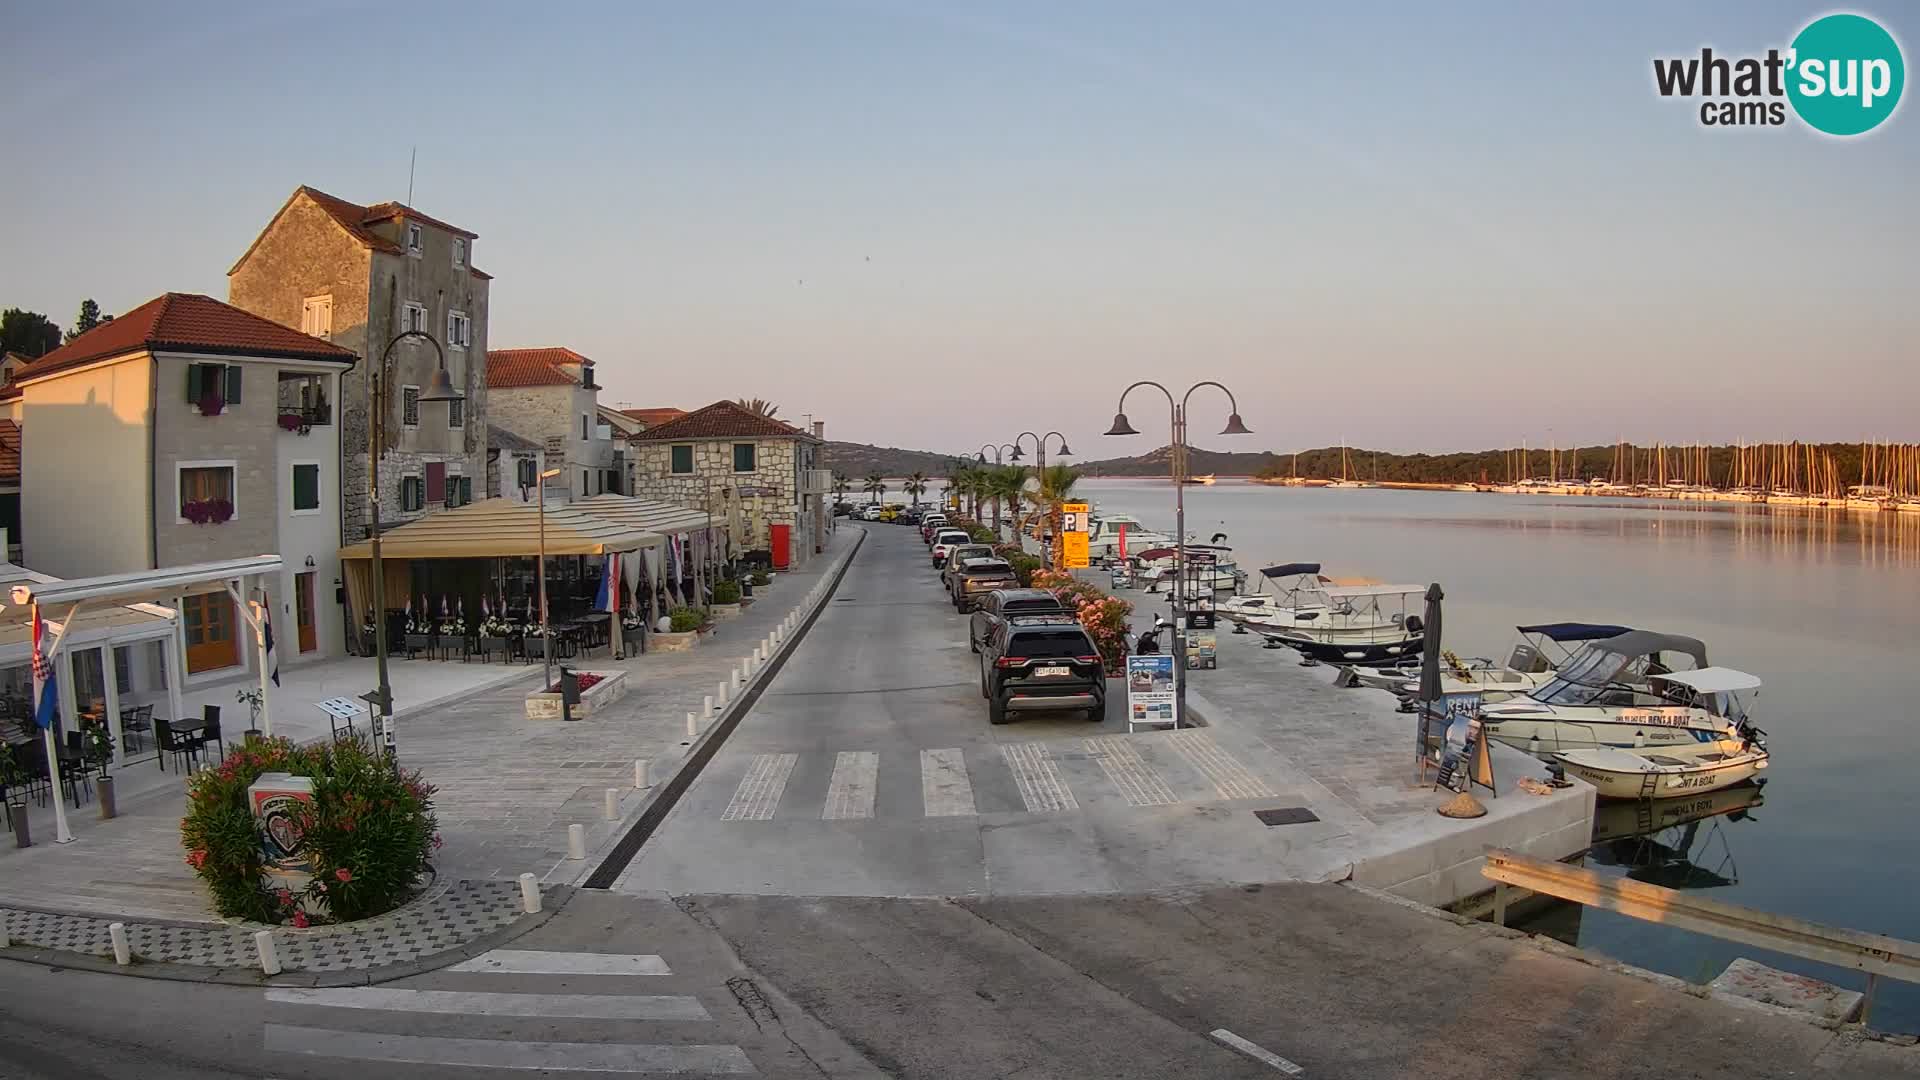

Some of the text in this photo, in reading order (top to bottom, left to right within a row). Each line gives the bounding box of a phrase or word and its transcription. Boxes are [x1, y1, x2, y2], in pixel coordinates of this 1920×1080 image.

[1446, 698, 1479, 710] RENT
[1673, 716, 1691, 726] BOAT
[1699, 775, 1717, 786] BOAT
